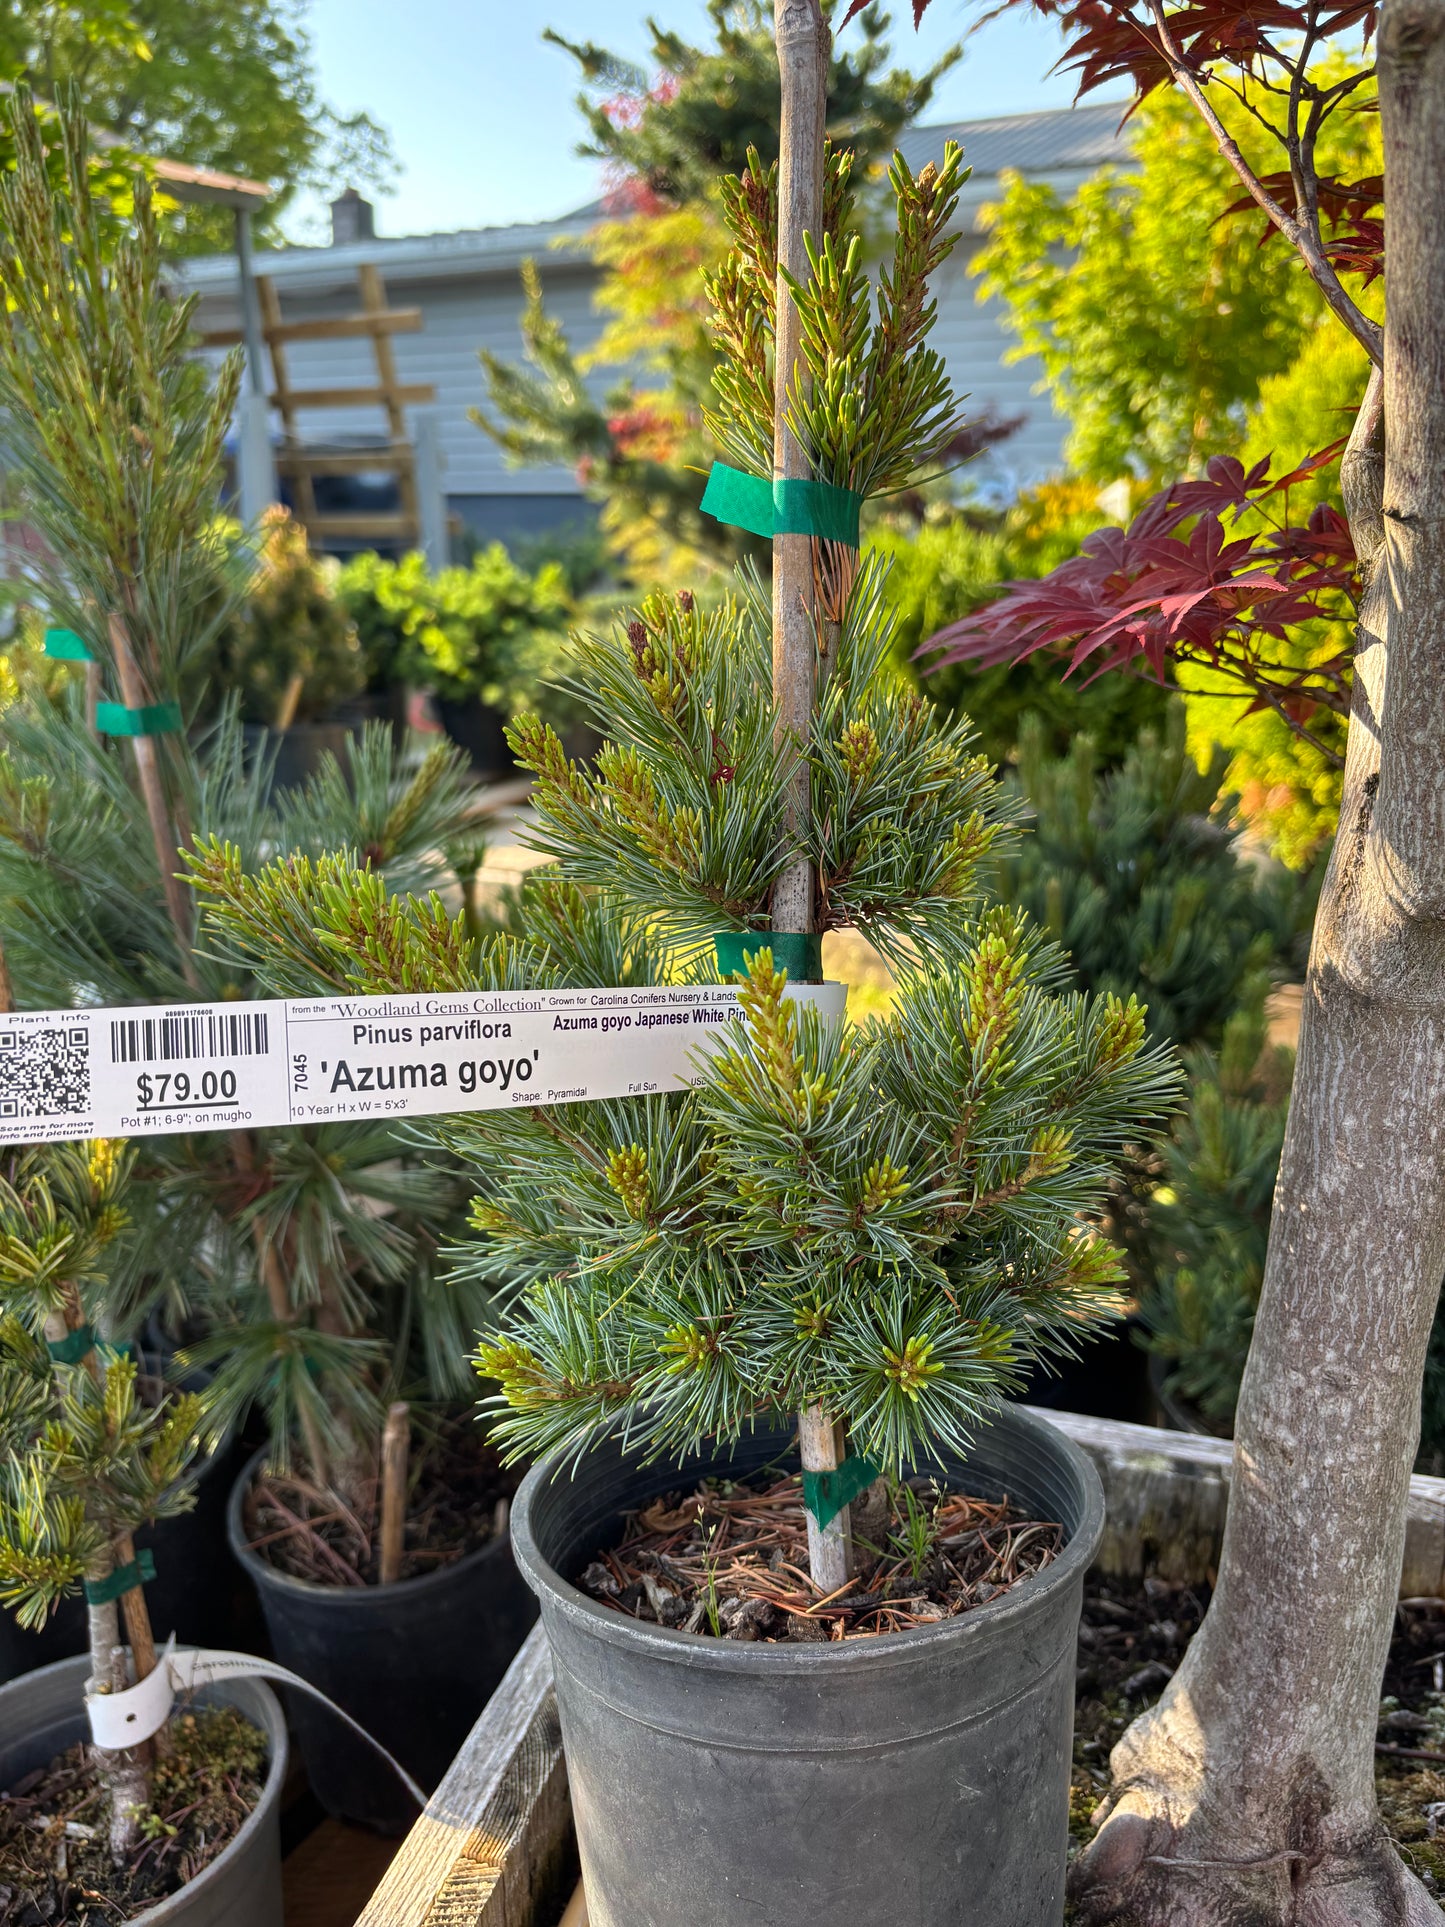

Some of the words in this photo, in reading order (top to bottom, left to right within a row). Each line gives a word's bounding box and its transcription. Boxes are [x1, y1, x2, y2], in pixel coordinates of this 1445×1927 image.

[292, 1006, 311, 1014] from
[314, 1004, 326, 1013] the
[331, 1001, 420, 1018] "Woodland
[426, 1000, 469, 1014] Gems
[473, 997, 546, 1013] Collection"
[549, 997, 575, 1005] Grown
[591, 994, 628, 1005] Carolina
[631, 993, 666, 1004] Conifers
[668, 992, 701, 1003] Nursery
[703, 991, 709, 1001] &
[9, 1016, 51, 1024] Plant
[553, 1014, 598, 1031] Azuma
[601, 1016, 632, 1032] goyo
[634, 1011, 689, 1029] Japanese
[692, 1008, 724, 1023] White
[353, 1024, 413, 1045] Pinus
[420, 1020, 512, 1046] parviflora
[293, 1054, 308, 1092] 7045
[321, 1060, 447, 1094] 'Azuma
[458, 1049, 539, 1093] goyo'
[136, 1069, 238, 1108] $79.00
[512, 1092, 543, 1102] Shape:
[547, 1087, 588, 1100] Pyramidal
[628, 1083, 642, 1093] Full
[643, 1082, 657, 1091] Sun
[291, 1106, 304, 1116] 10
[307, 1104, 334, 1115] Year
[337, 1103, 346, 1113] H
[349, 1105, 356, 1113] x
[358, 1101, 371, 1112] W
[384, 1099, 408, 1110] 5'x3'
[120, 1117, 142, 1128] Pot
[144, 1116, 162, 1128] #1;
[165, 1114, 192, 1126] 6-9";
[195, 1114, 209, 1123] on
[213, 1110, 252, 1125] mugho
[46, 1128, 93, 1138] pictures!
